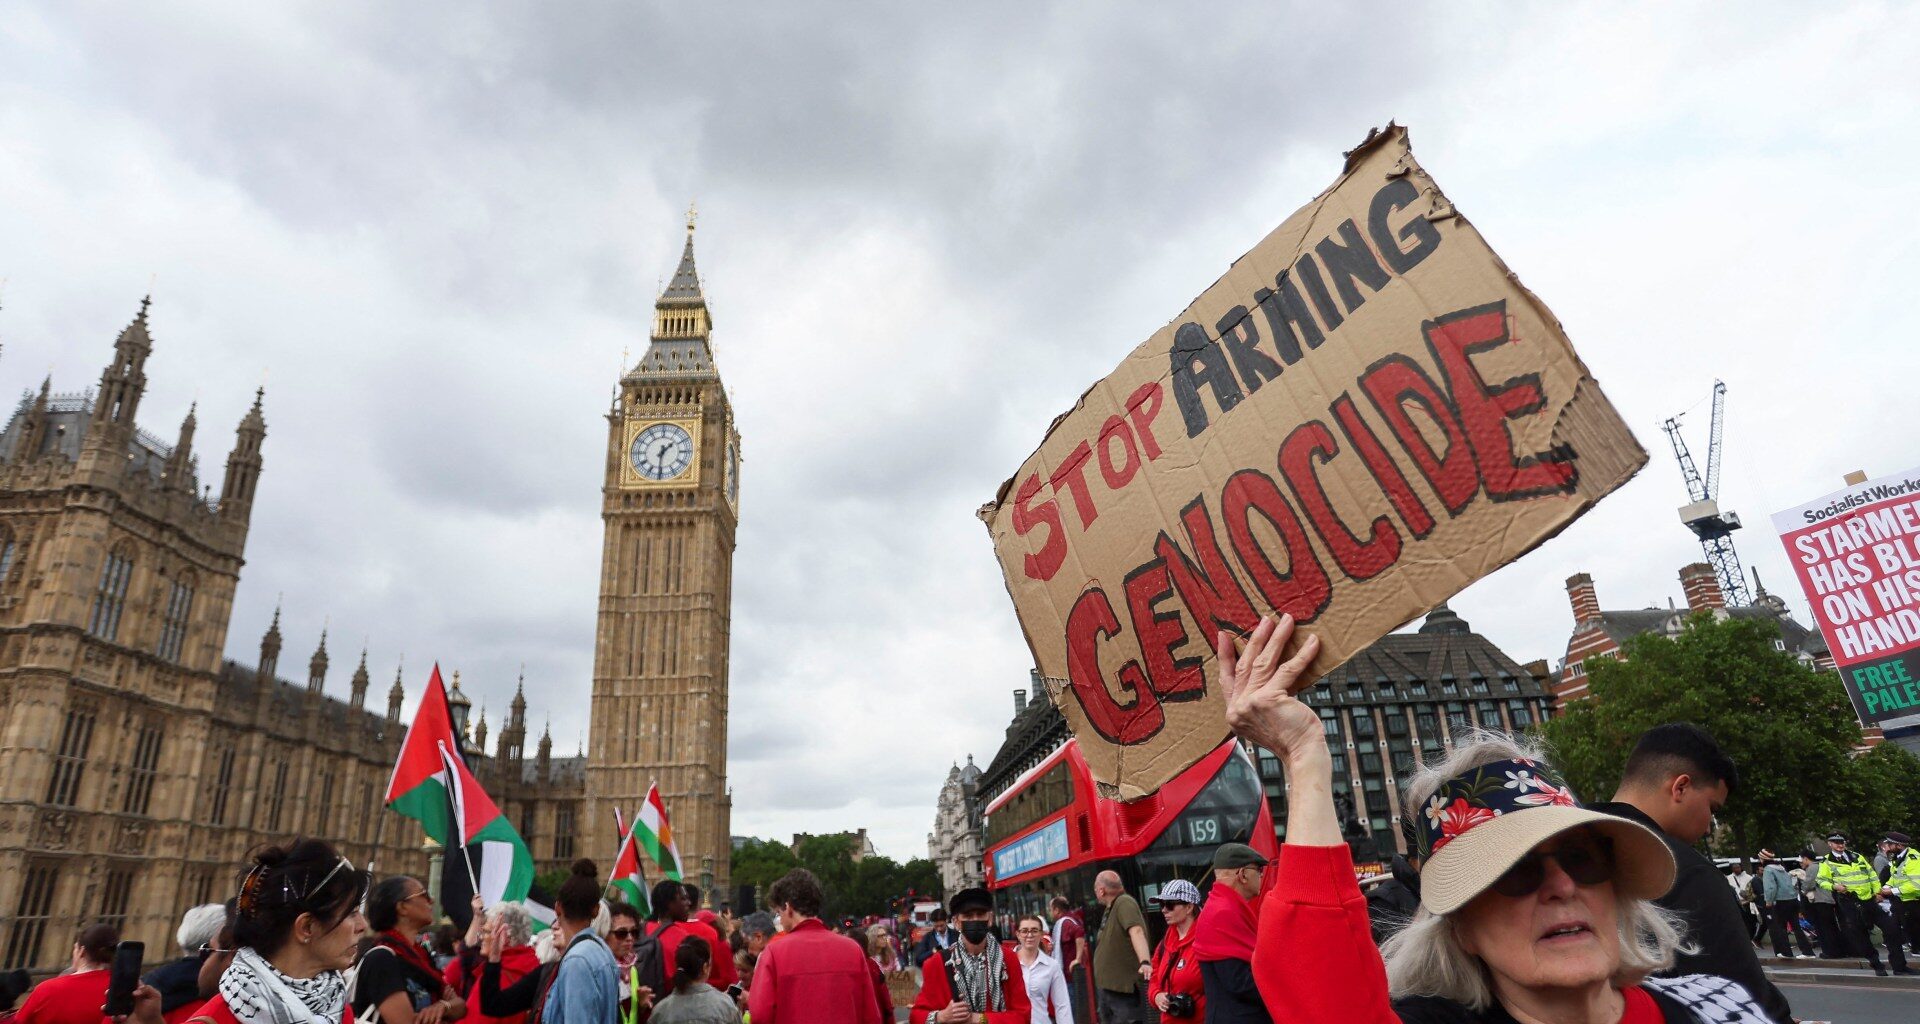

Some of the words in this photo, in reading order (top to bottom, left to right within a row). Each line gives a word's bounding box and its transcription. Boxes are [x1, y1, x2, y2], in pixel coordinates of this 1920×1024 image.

[1011, 381, 1163, 580] STOP
[1169, 179, 1442, 439] ARMING
[1065, 298, 1579, 745] GENOCIDE
[1803, 490, 1873, 523] Socialist
[1869, 479, 1920, 500] Worke
[1807, 552, 1873, 596] HAS
[1872, 534, 1920, 575] BL
[1822, 587, 1873, 625] ON
[1834, 607, 1920, 658] HAND
[1852, 659, 1912, 691] FREE
[1862, 681, 1920, 715] PALE
[1190, 819, 1217, 842] 159
